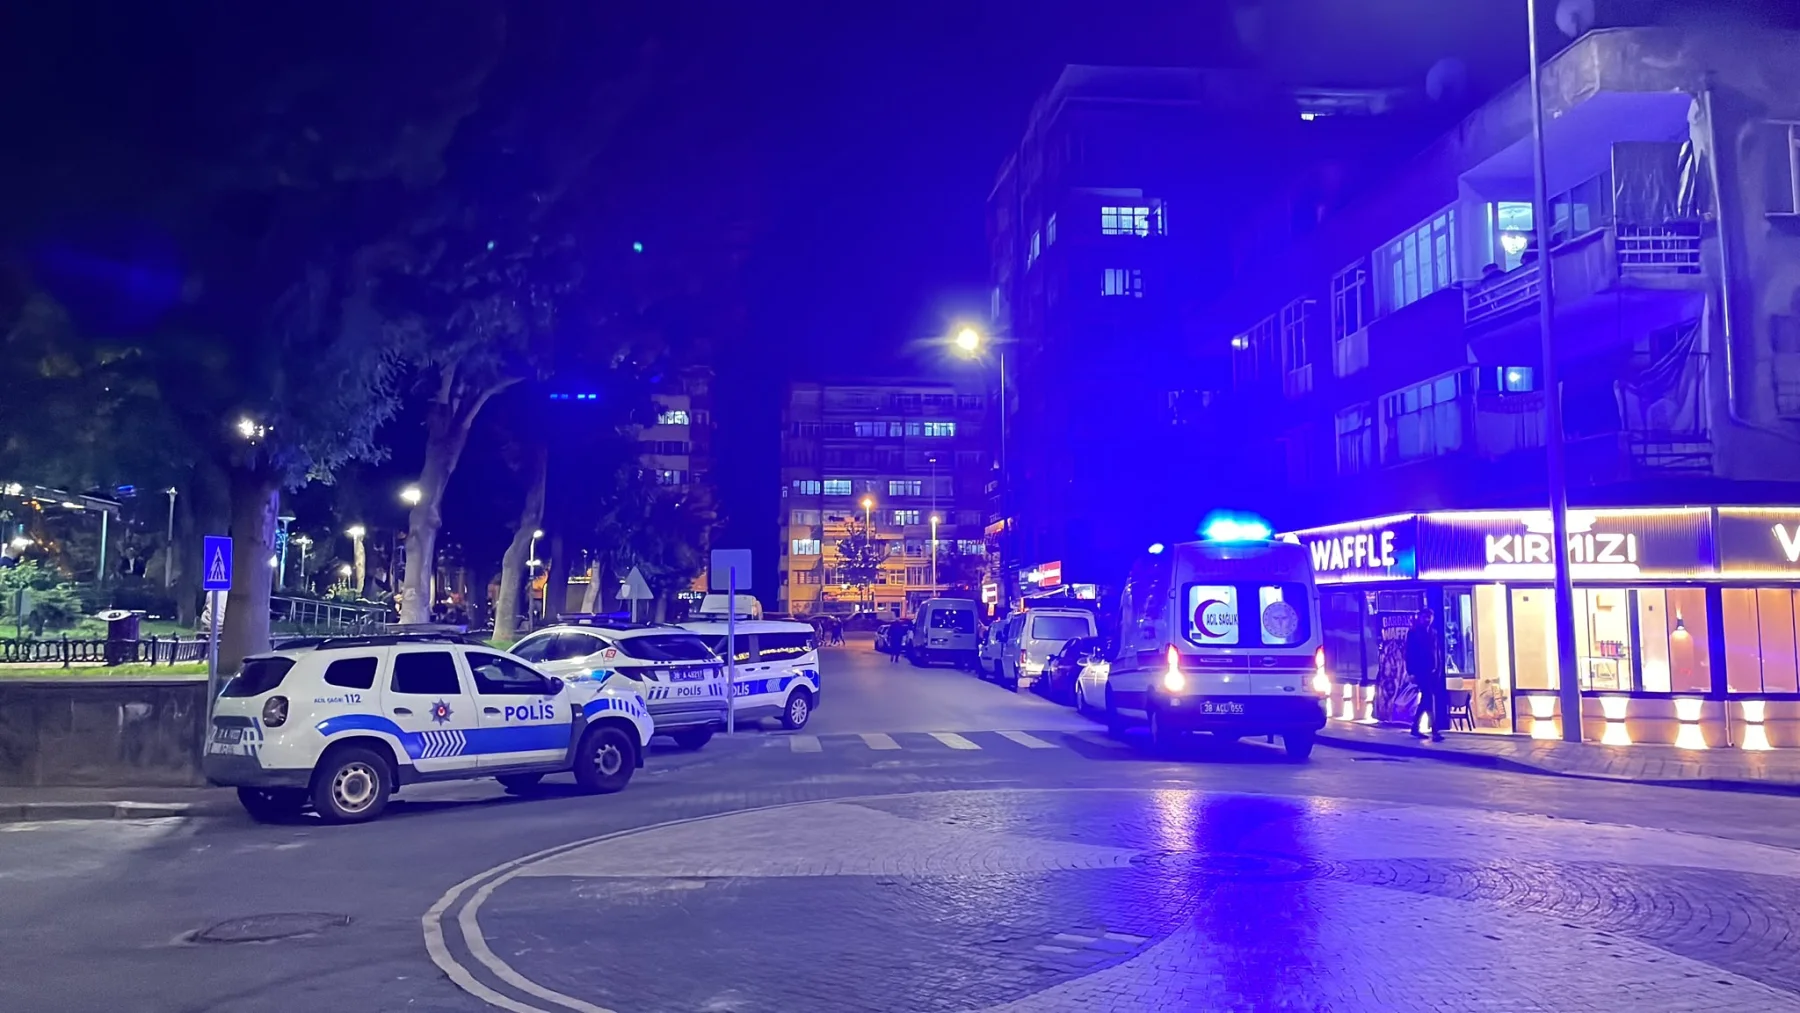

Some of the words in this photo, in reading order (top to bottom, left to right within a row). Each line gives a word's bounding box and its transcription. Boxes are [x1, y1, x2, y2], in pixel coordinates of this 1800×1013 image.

[1310, 531, 1395, 571] WAFFLE
[1486, 533, 1637, 563] KIRMIZI
[1381, 627, 1409, 641] WAFF
[677, 685, 702, 696] POLİS
[733, 681, 750, 697] OLİS
[344, 693, 361, 704] 112
[505, 699, 554, 721] POLİS
[1204, 703, 1213, 712] 38
[1230, 703, 1243, 713] 055
